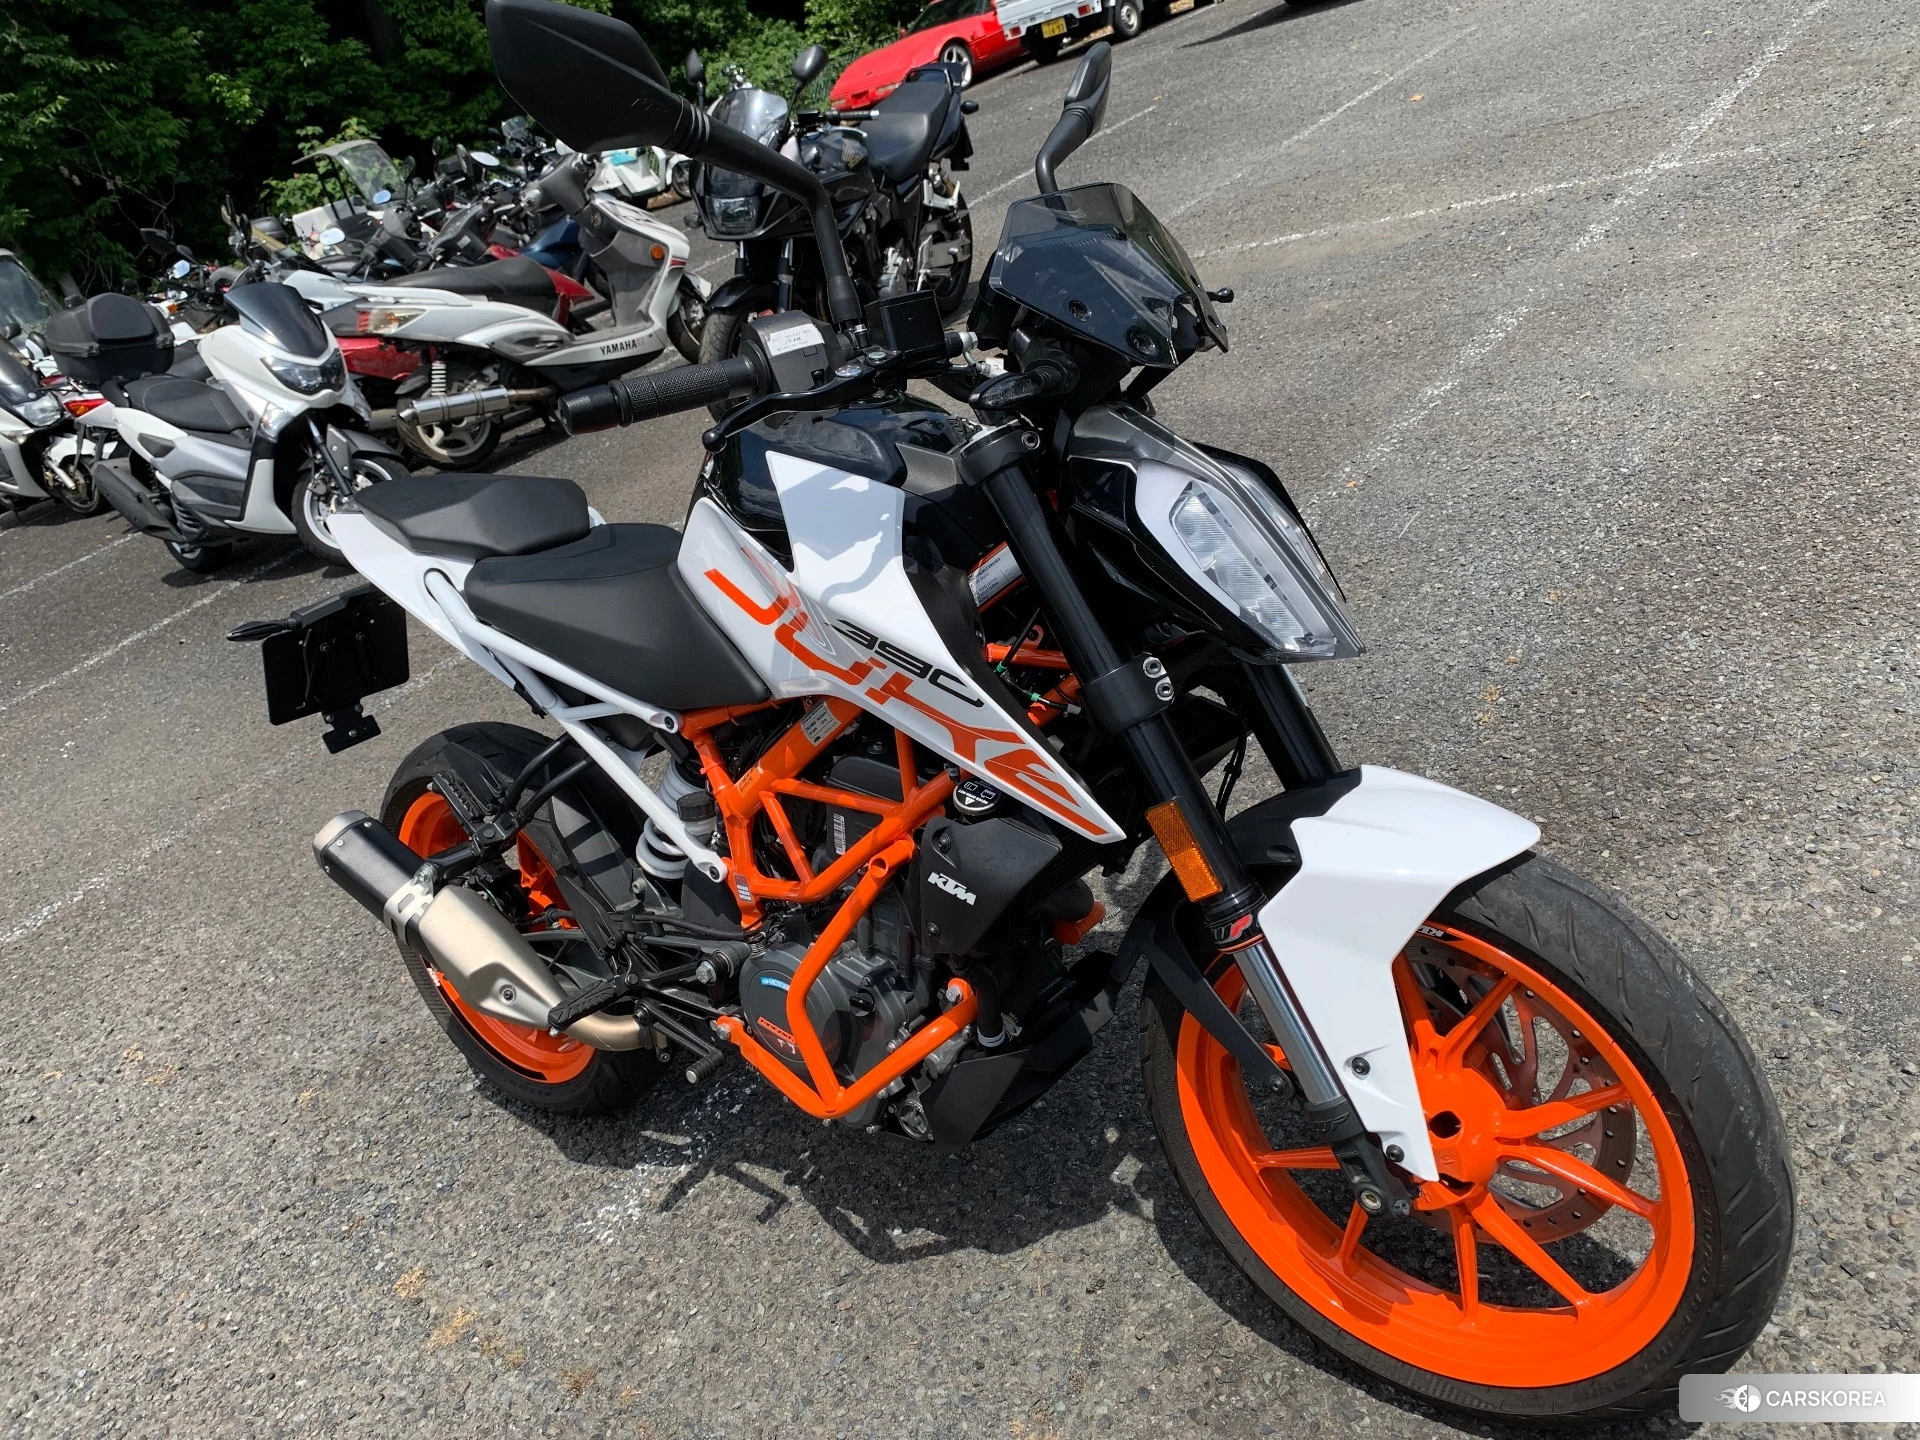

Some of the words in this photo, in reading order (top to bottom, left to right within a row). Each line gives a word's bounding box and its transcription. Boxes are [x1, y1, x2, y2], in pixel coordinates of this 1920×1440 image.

[600, 339, 638, 356] YAMAHA
[703, 546, 1110, 836] DUKE
[823, 618, 985, 708] 390
[927, 871, 977, 906] KTM
